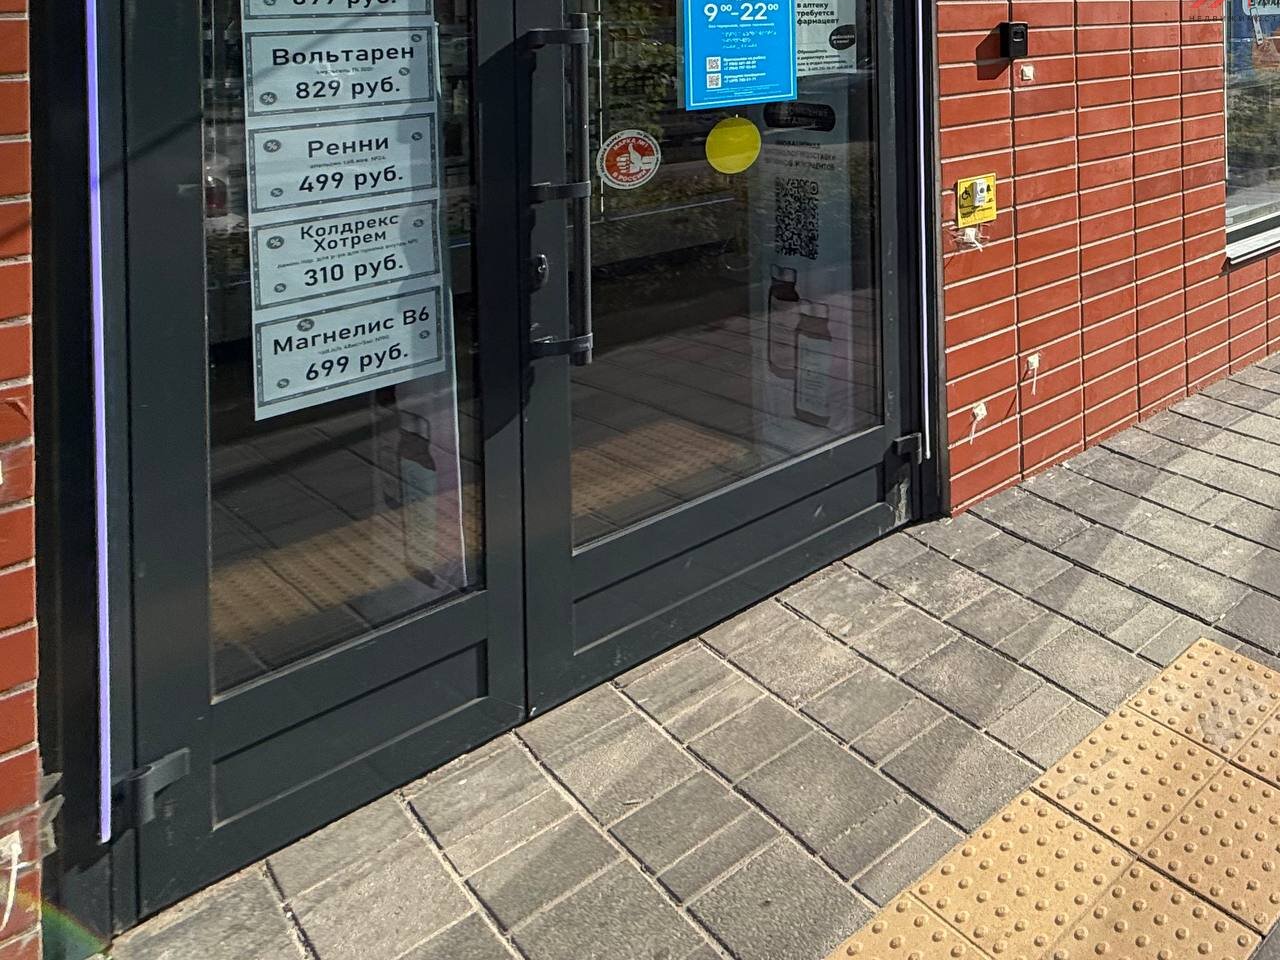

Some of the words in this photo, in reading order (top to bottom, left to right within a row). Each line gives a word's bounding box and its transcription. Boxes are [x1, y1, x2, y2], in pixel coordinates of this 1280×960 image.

[797, 10, 835, 18] требуется
[802, 2, 829, 10] аптеку
[797, 18, 840, 26] фармацевт
[272, 45, 415, 66] Вольтарен
[296, 79, 341, 100] 829
[351, 76, 400, 100] руб.
[308, 137, 389, 158] Ренни
[299, 171, 344, 194] 499
[354, 165, 403, 191] руб.
[300, 215, 399, 240] Колдрекс
[313, 230, 387, 253] Хотрем
[304, 263, 344, 287] 310
[354, 254, 403, 281] руб.
[273, 317, 395, 356] Магнелис
[305, 355, 350, 381] 699
[359, 343, 408, 373] руб.
